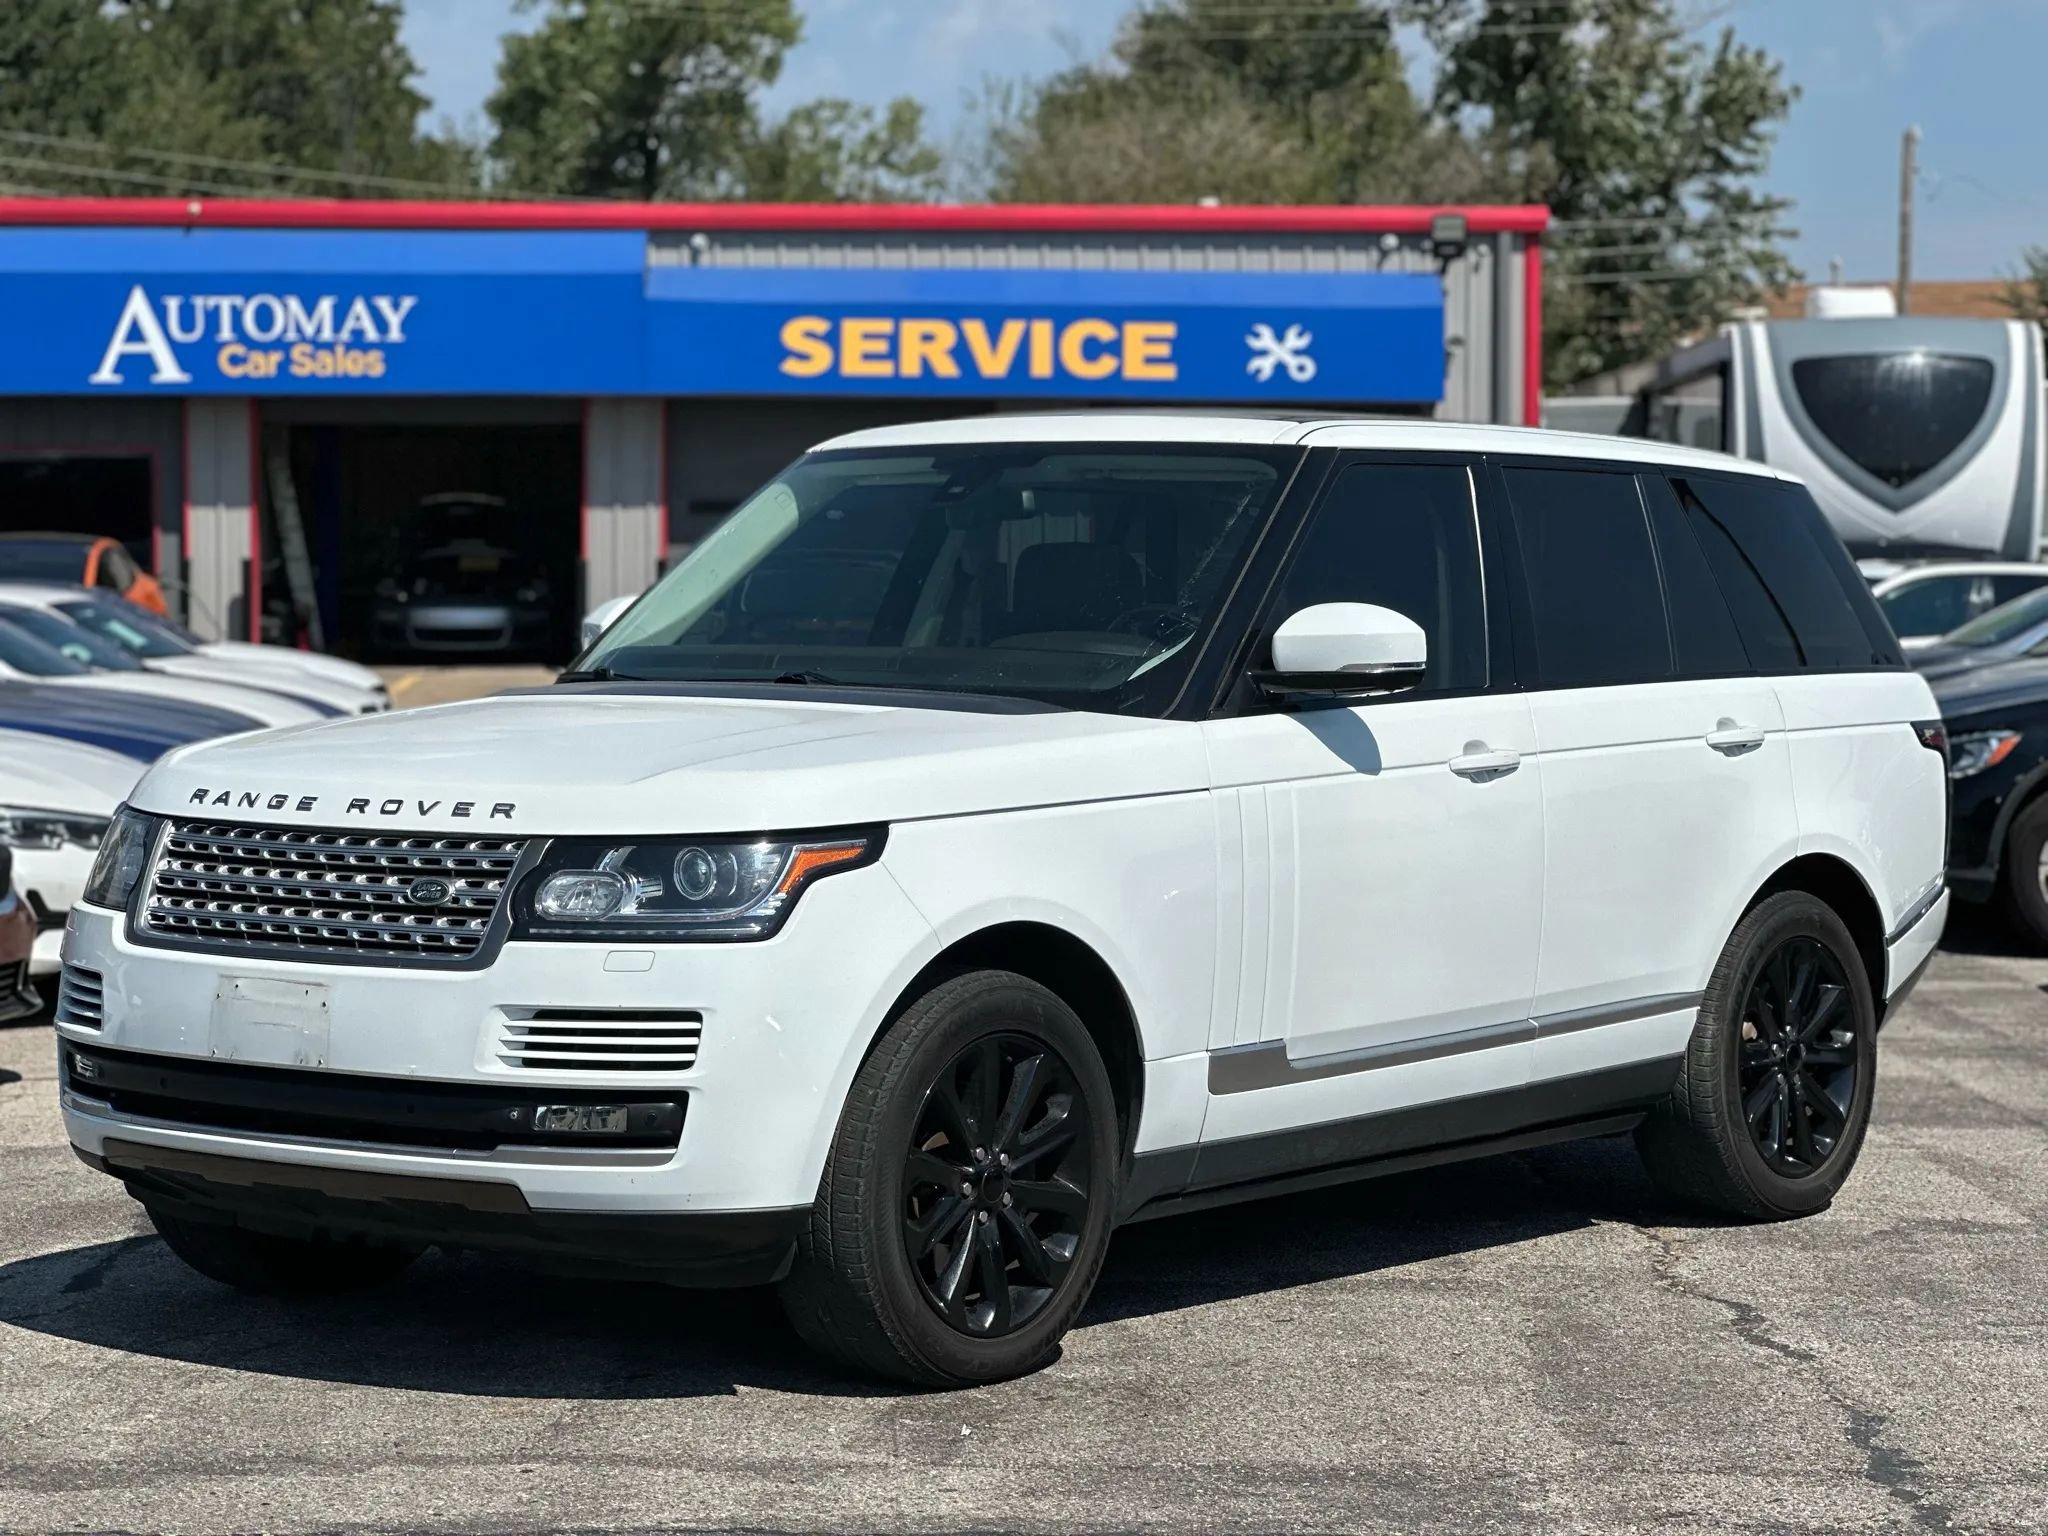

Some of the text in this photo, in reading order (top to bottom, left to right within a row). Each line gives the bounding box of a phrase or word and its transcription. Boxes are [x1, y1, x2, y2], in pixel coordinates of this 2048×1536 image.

[88, 284, 418, 385] AUTOMAY
[217, 342, 387, 378] Car Sales
[779, 315, 1178, 382] SERVICE
[188, 787, 517, 820] RANGE ROVER
